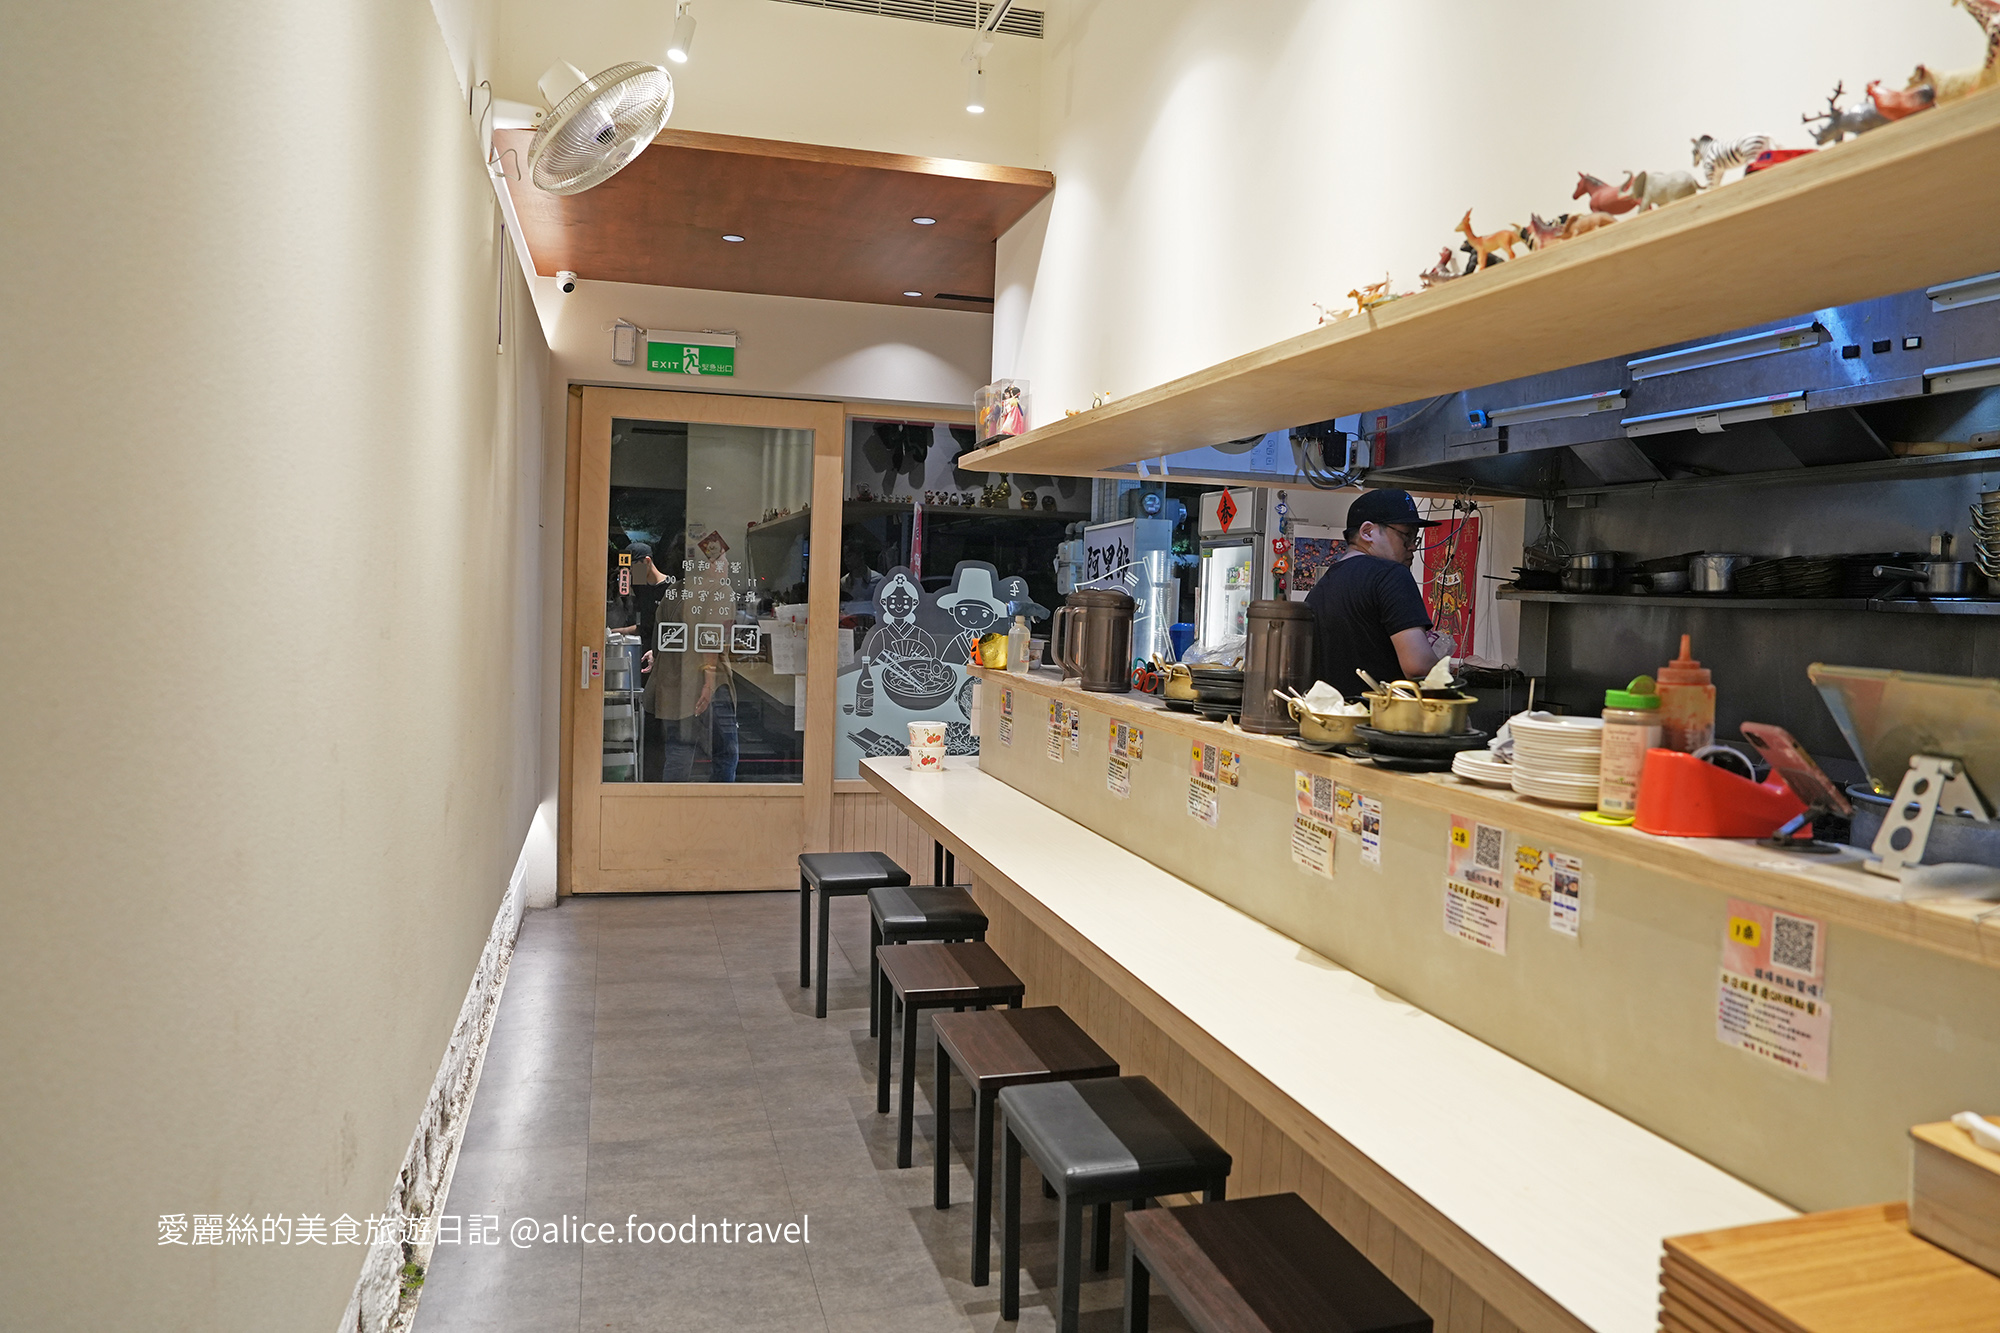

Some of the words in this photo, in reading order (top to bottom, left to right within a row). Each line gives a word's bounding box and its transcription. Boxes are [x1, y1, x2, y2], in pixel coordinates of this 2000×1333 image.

[651, 360, 679, 369] EXIT
[701, 363, 733, 373] 緊急出口
[1220, 496, 1233, 525] 春
